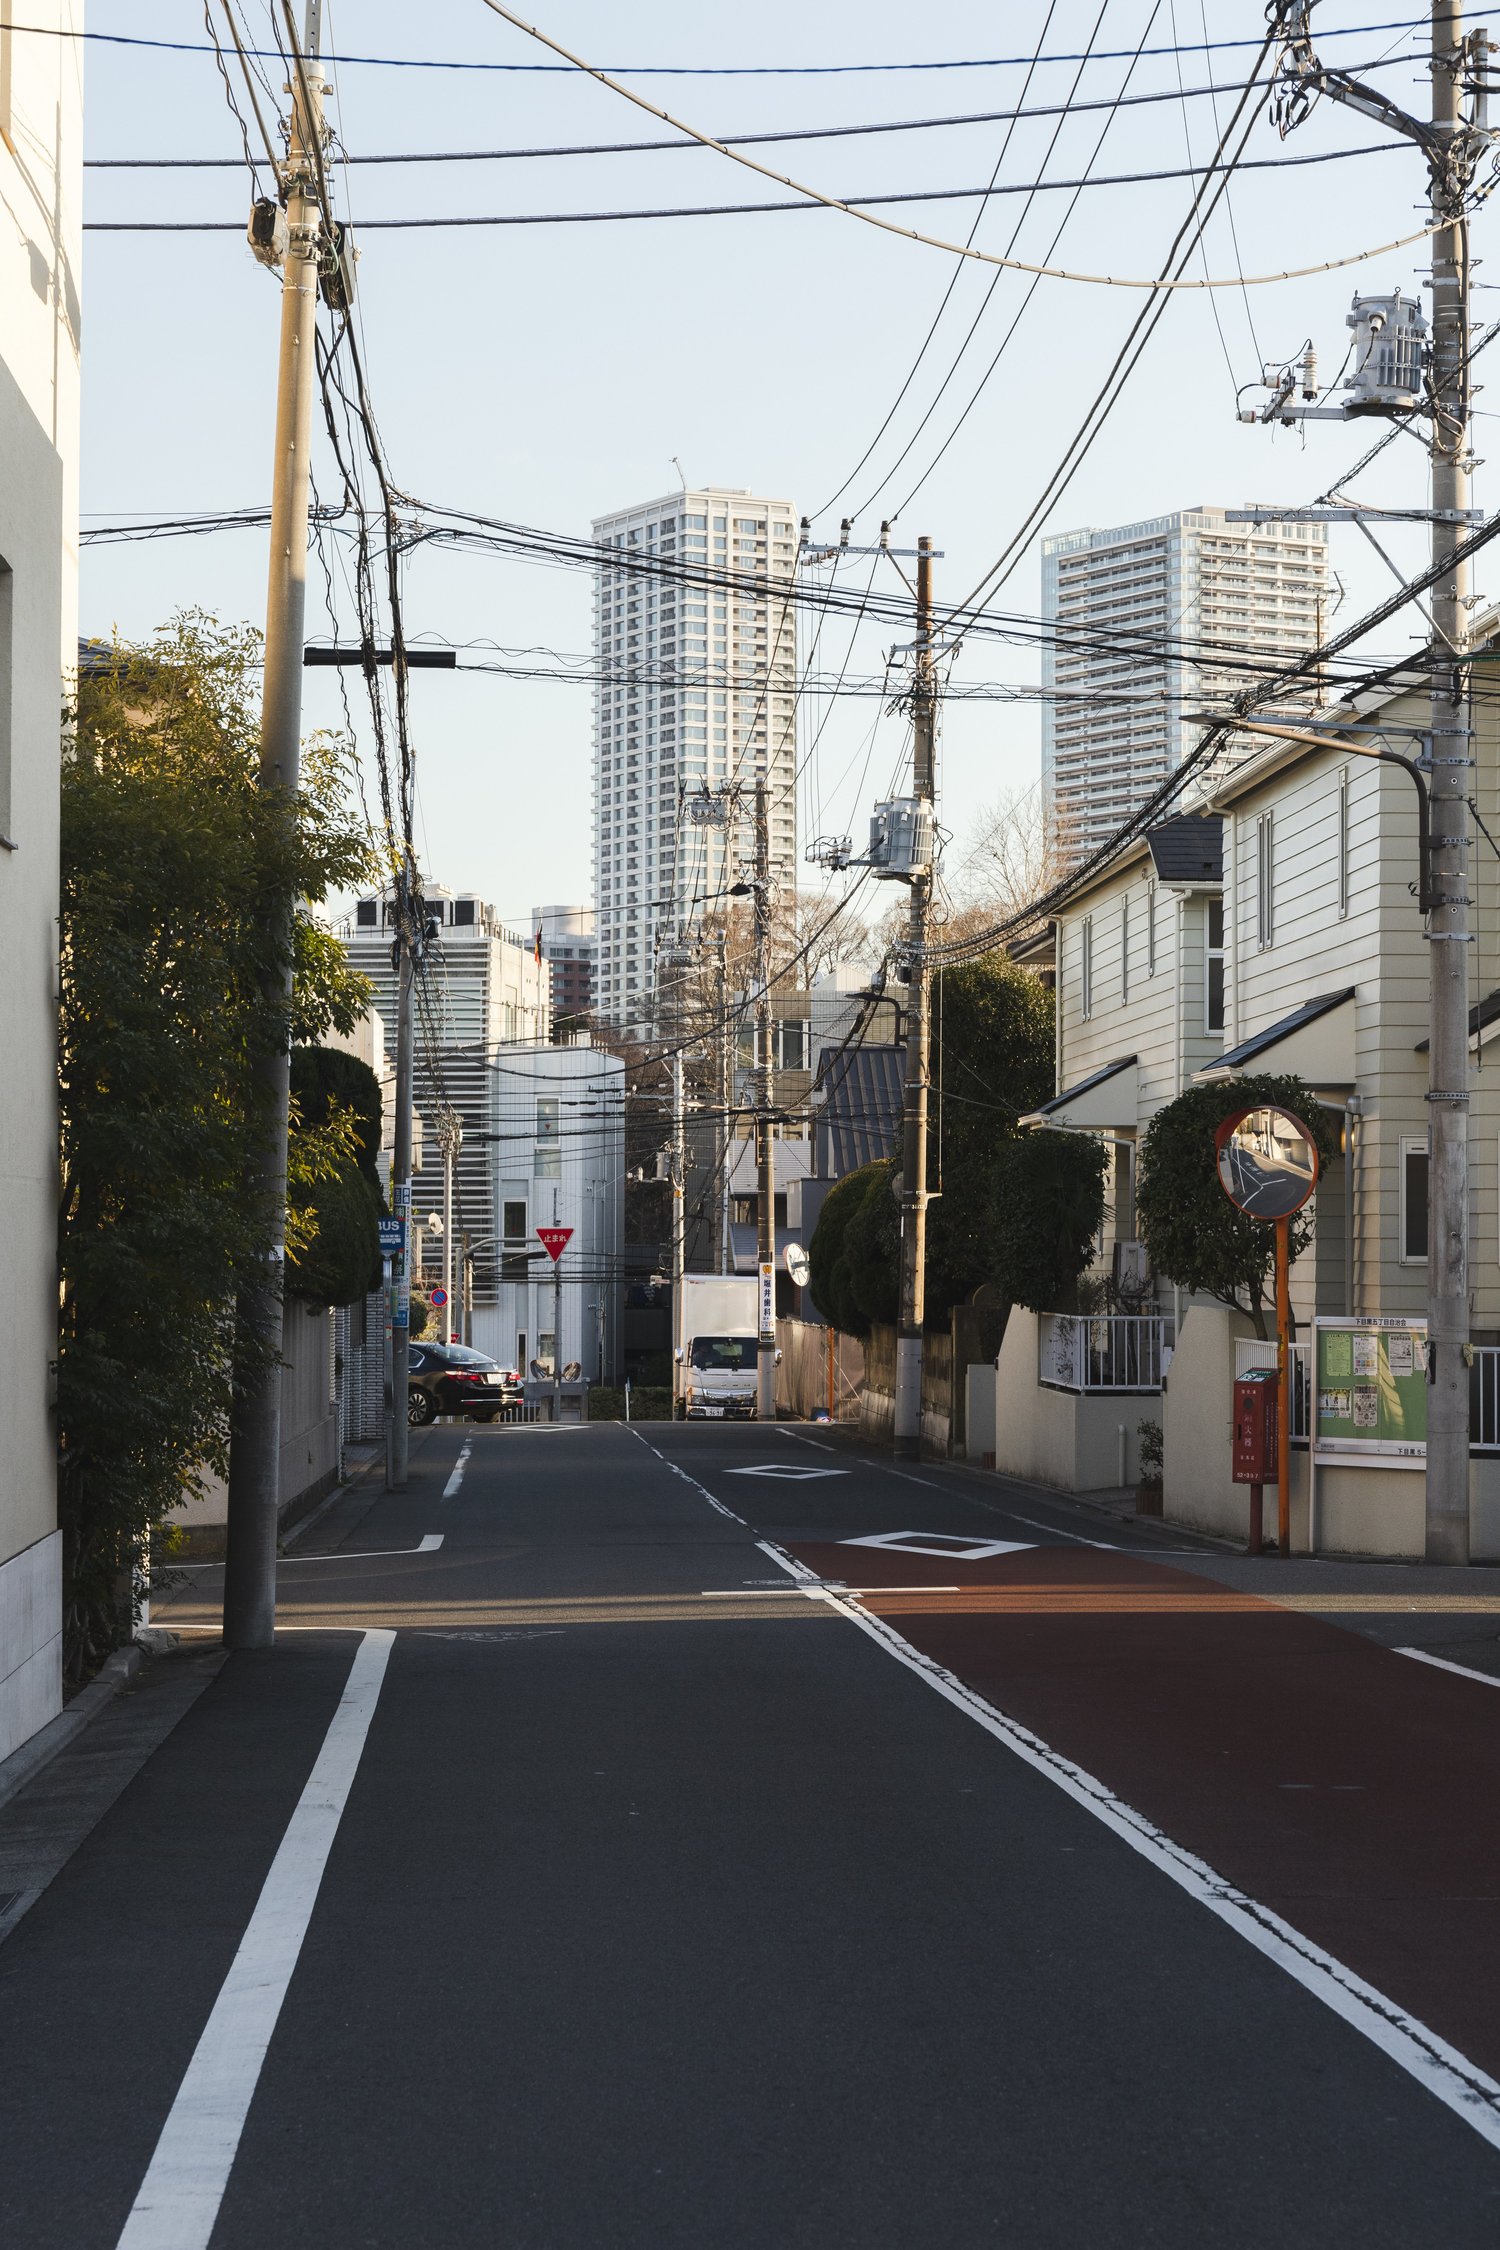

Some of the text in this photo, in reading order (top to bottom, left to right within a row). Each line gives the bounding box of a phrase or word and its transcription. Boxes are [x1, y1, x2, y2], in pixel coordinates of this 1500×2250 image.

[544, 1234, 567, 1243] 止まれ
[1355, 1318, 1407, 1327] 下目黒五丁目自治会
